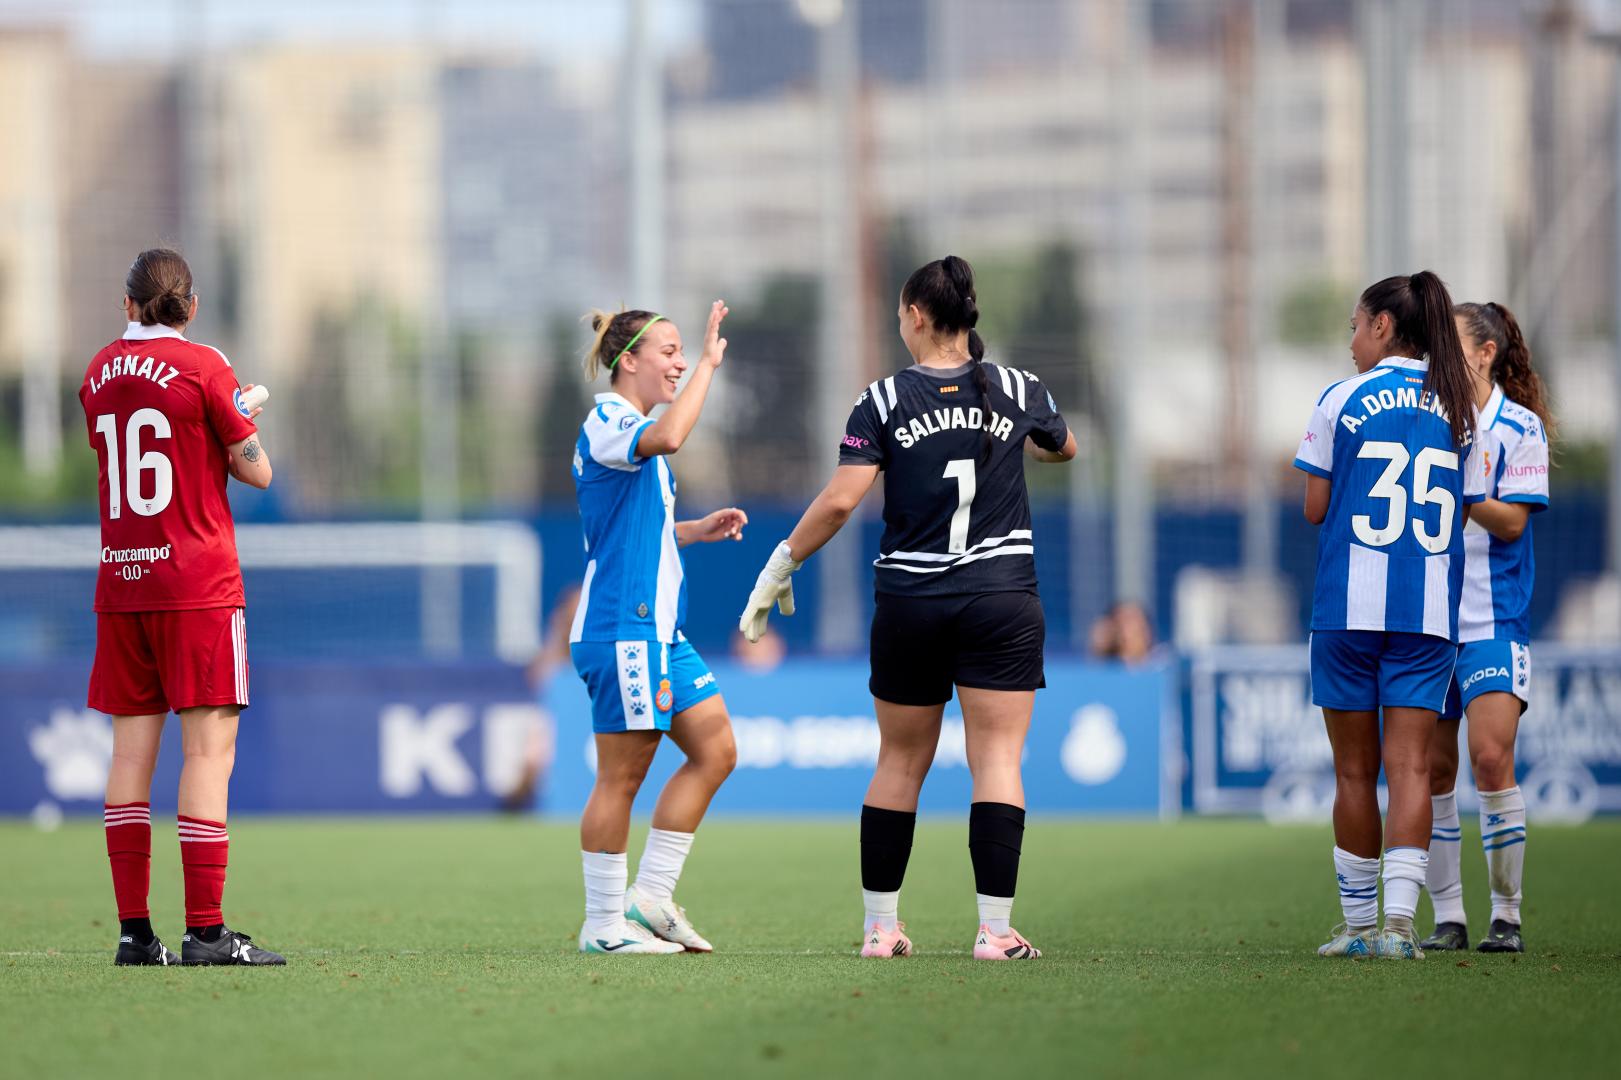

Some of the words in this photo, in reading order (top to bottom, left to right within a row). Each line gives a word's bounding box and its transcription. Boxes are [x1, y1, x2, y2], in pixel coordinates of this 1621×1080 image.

[95, 407, 173, 520] 16
[894, 407, 1015, 449] SALVADOR
[942, 458, 977, 553] 1
[1351, 440, 1459, 554] 35
